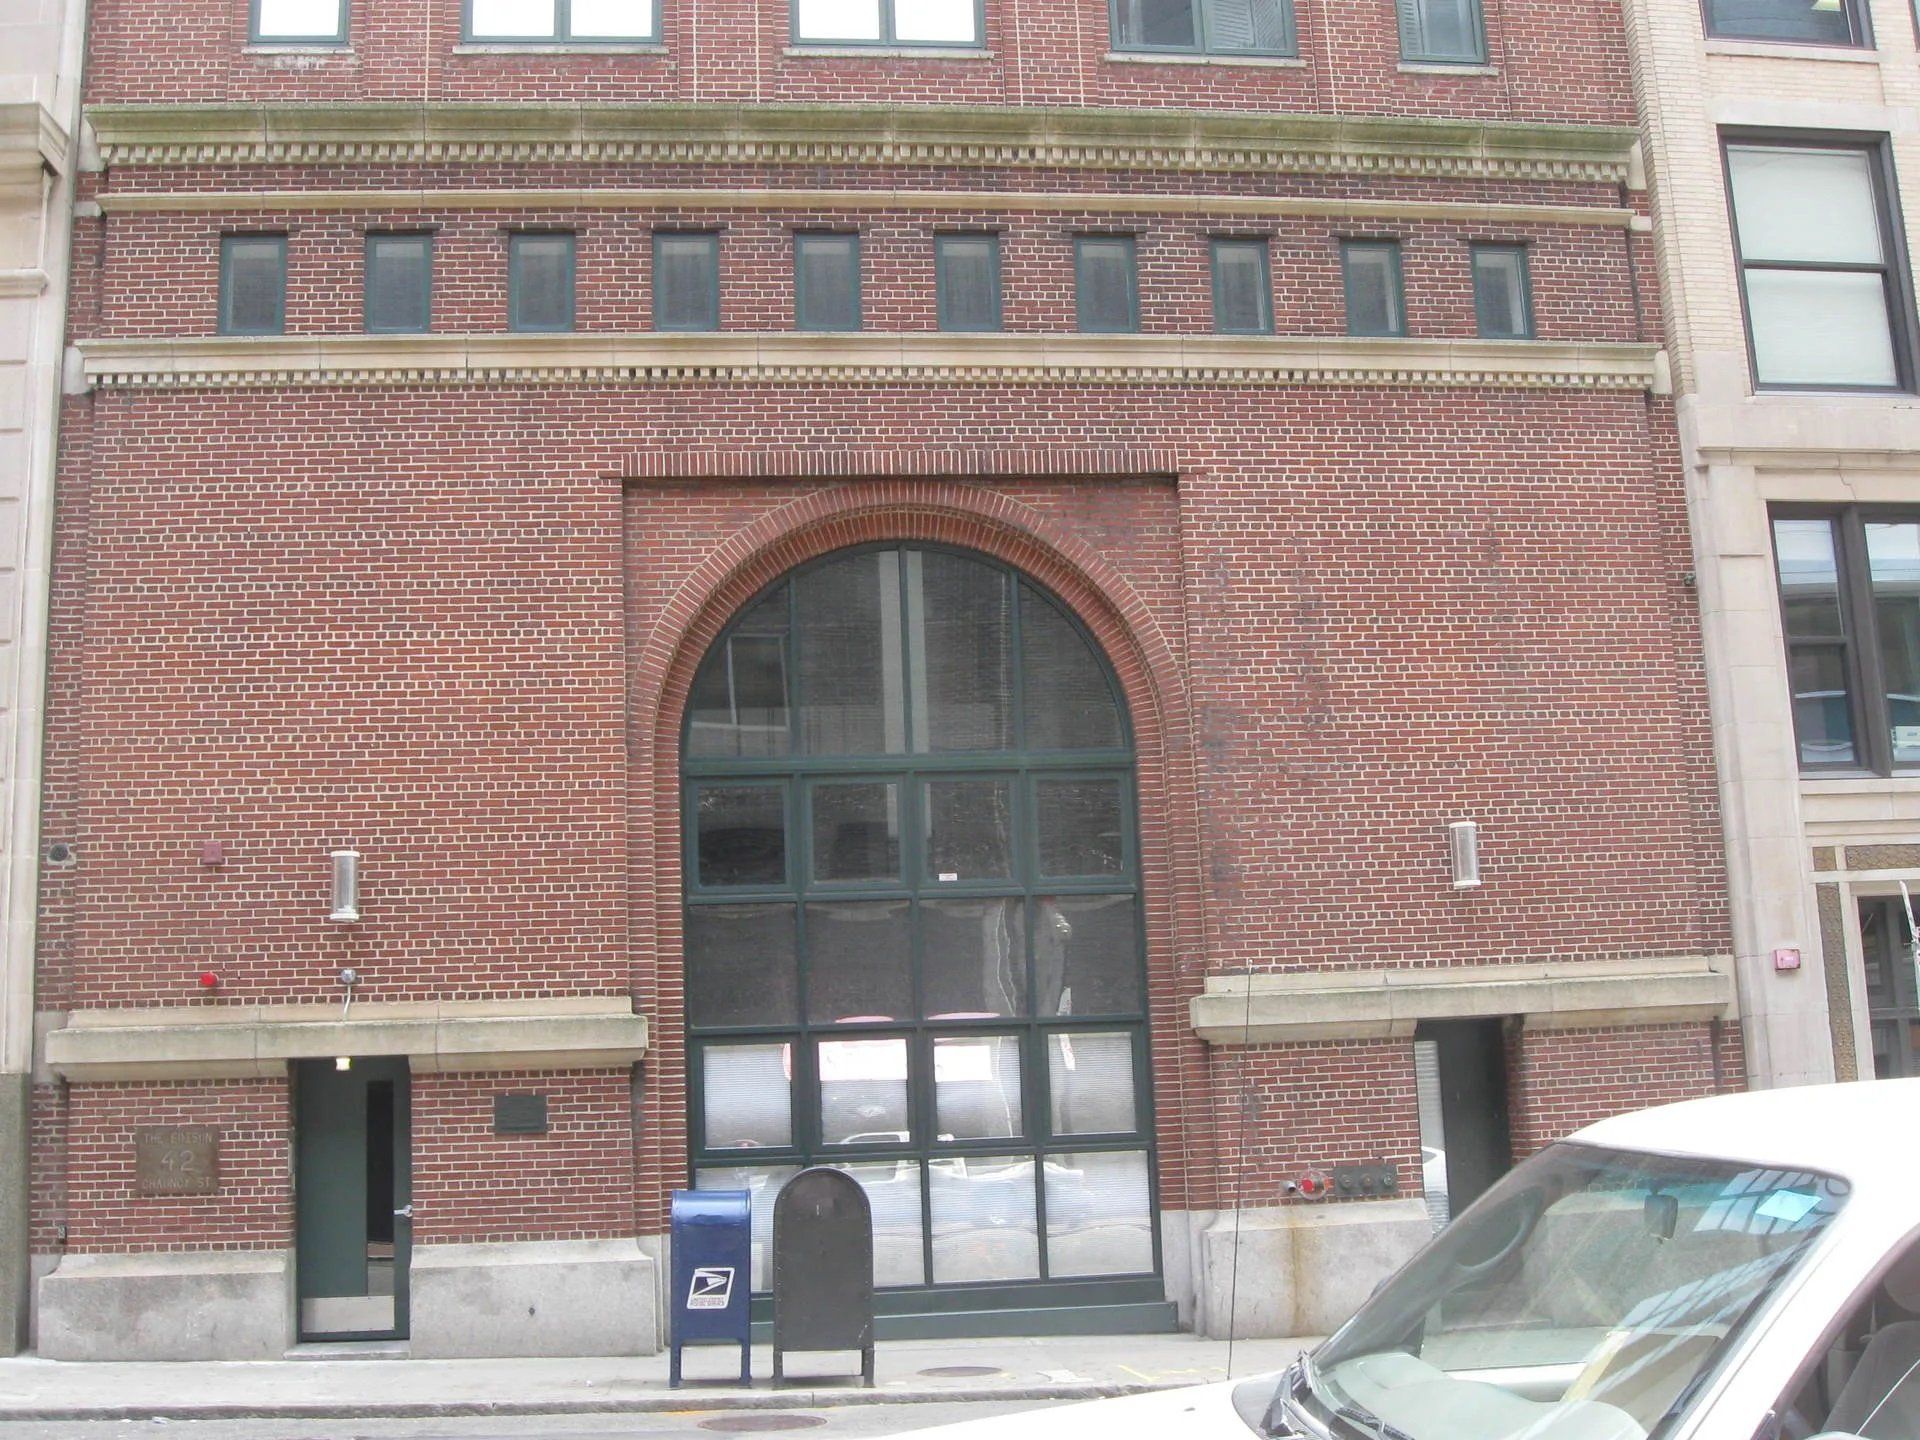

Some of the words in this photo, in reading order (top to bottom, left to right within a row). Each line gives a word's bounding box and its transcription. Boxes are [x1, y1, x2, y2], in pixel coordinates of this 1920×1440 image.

[144, 1132, 164, 1145] THE
[161, 1150, 194, 1172] 42
[197, 1176, 211, 1188] ST
